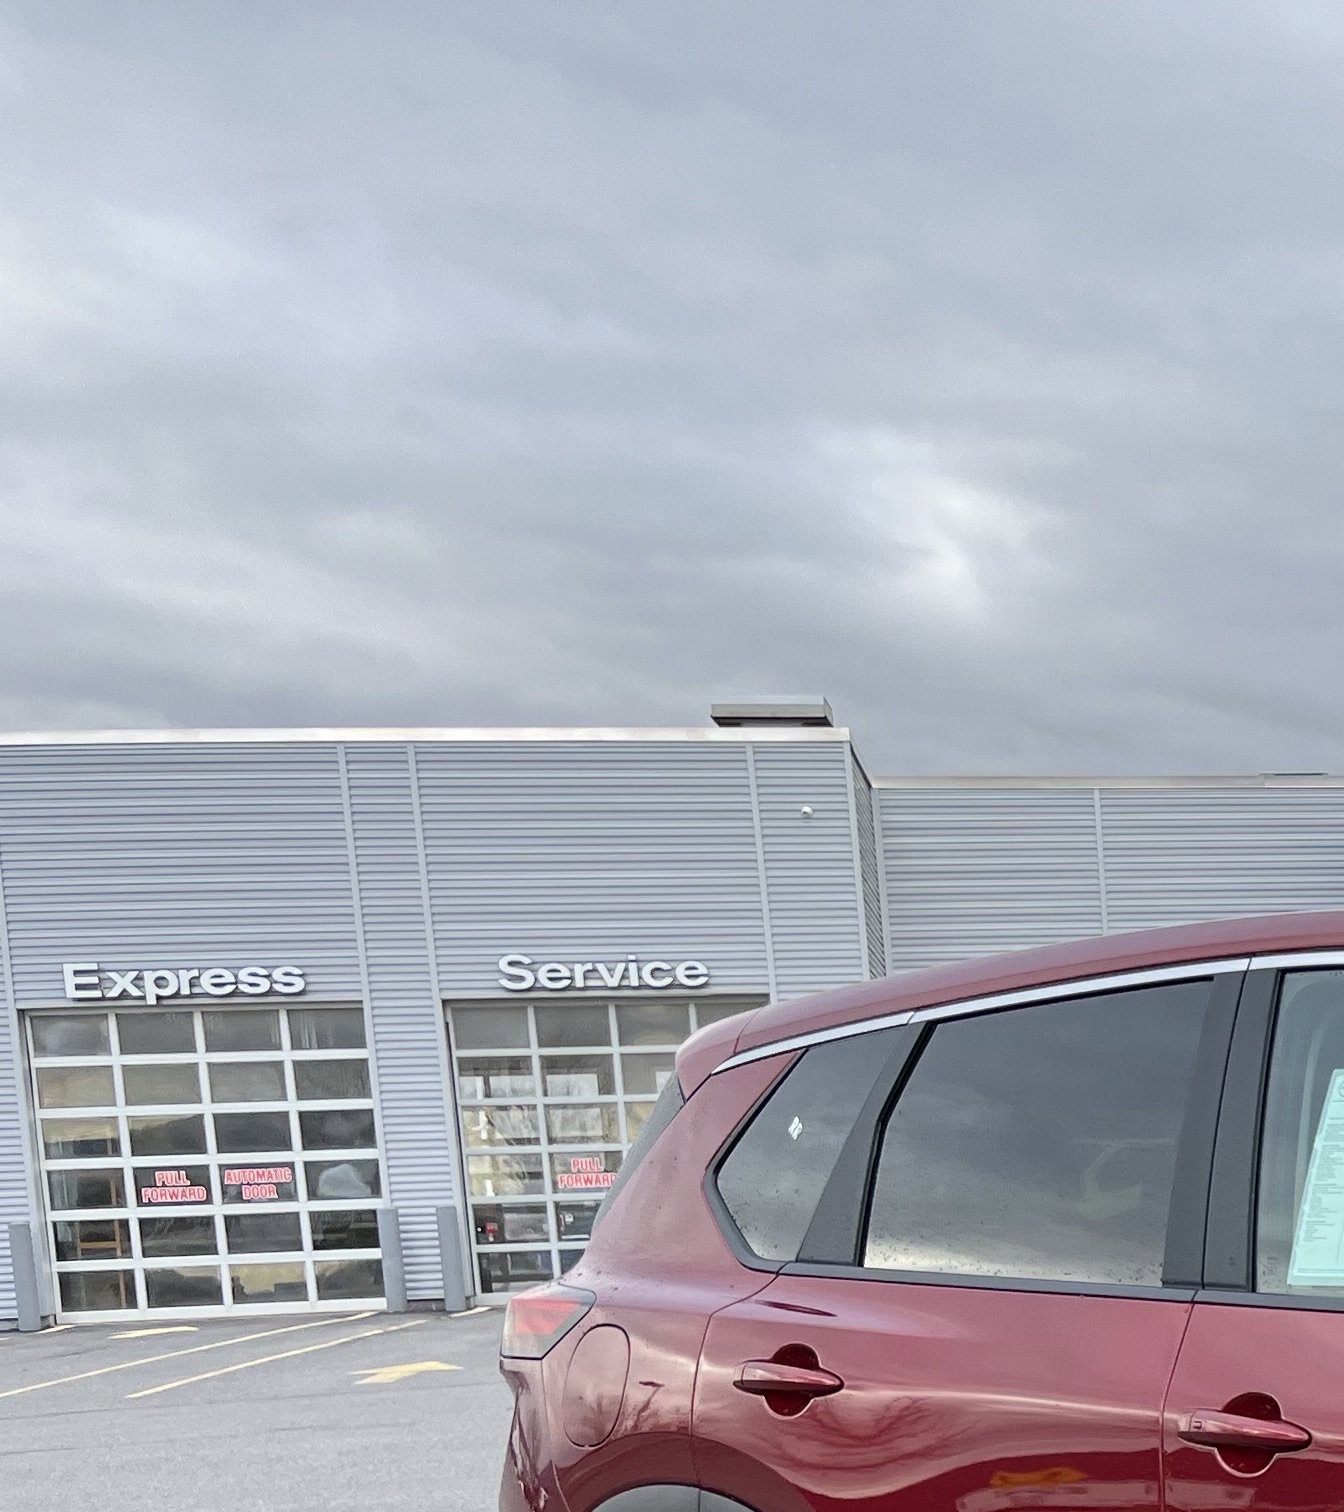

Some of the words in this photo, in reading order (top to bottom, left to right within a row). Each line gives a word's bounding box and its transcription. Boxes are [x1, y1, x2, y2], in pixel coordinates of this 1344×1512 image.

[498, 953, 709, 991] Service
[62, 962, 305, 1004] Express
[571, 1158, 604, 1172] PULL
[155, 1171, 190, 1185] PULL
[224, 1167, 292, 1184] AUTOMATIC
[142, 1186, 207, 1202] FORWARD
[242, 1184, 278, 1200] DOOR
